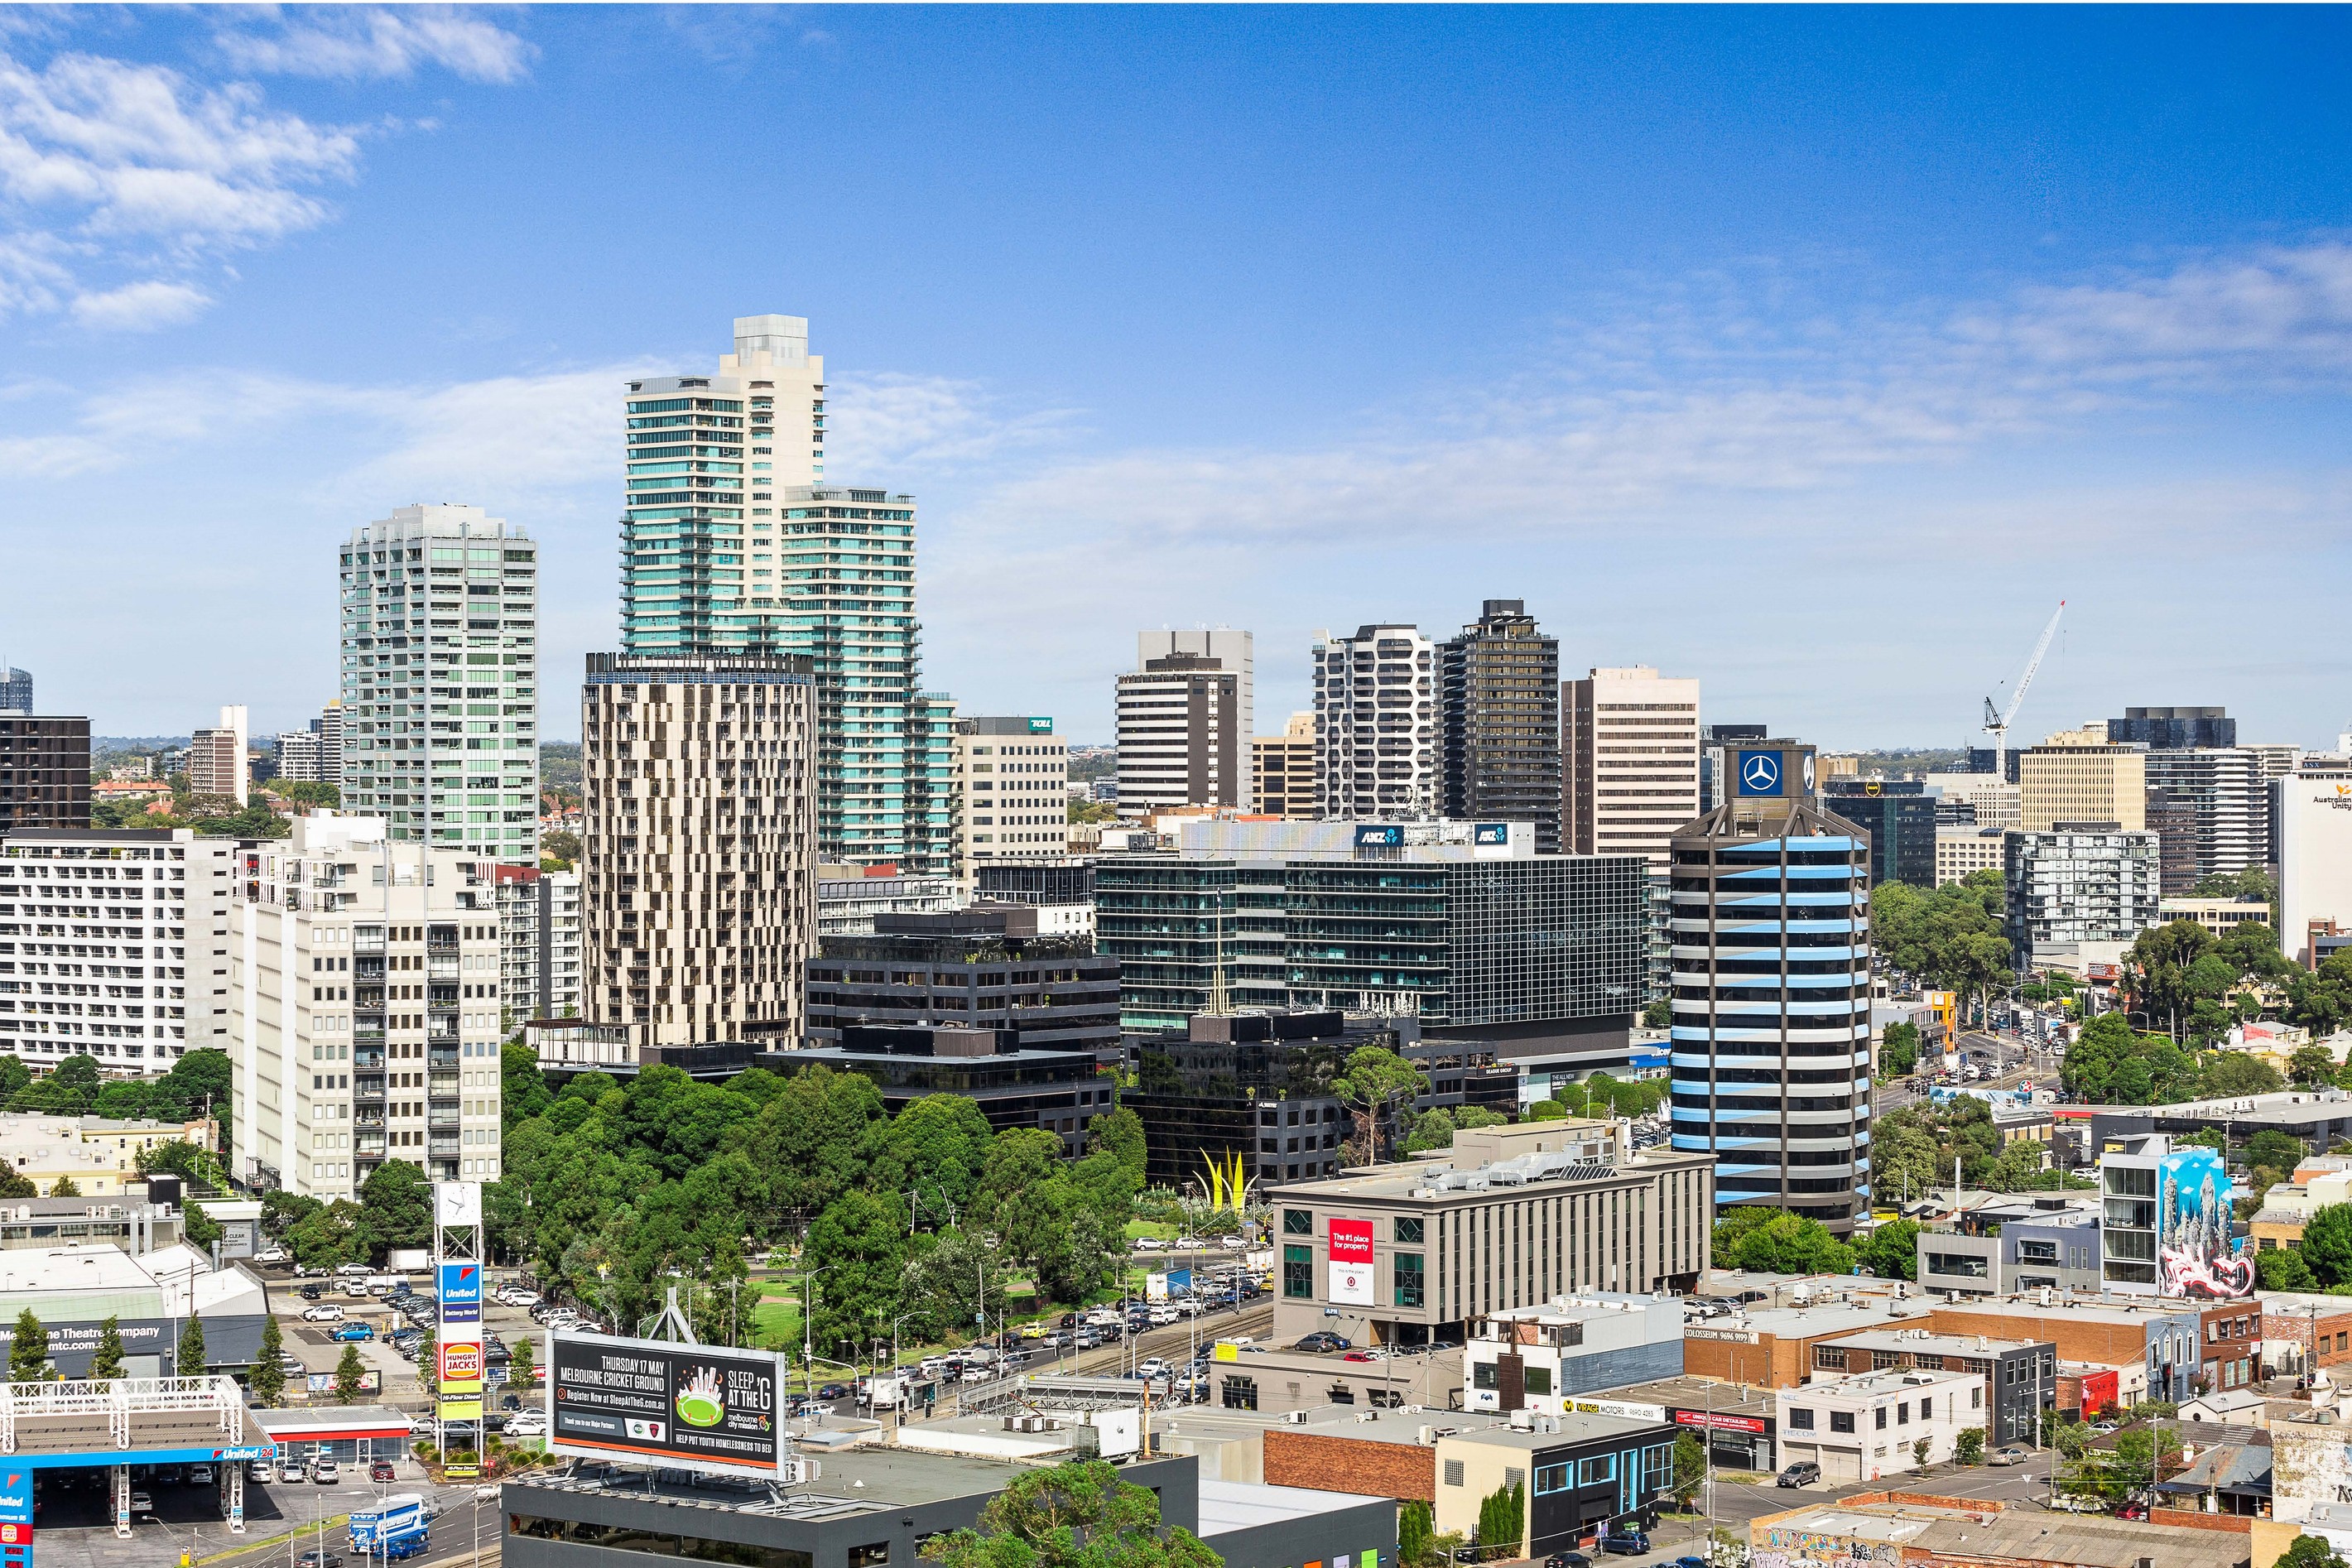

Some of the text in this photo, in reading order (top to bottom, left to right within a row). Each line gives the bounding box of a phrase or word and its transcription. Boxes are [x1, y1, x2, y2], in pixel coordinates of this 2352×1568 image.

[1031, 719, 1051, 728] TOLL
[2331, 802, 2352, 811] Unity
[1361, 832, 1386, 844] ANZ
[1479, 831, 1497, 842] ANZ
[1333, 1232, 1369, 1243] The #1 place
[1343, 1243, 1368, 1252] property
[445, 1288, 477, 1298] United
[62, 1327, 104, 1340] Theatre
[1685, 1329, 1748, 1341] COLOSSEUM 9696 9199
[48, 1341, 105, 1351] mtc.com.a
[601, 1355, 665, 1376] THURSDAY 17 MAY
[560, 1367, 665, 1392] MELBOURNE CRICKET GROUND
[728, 1370, 754, 1390] SLEEP
[566, 1389, 666, 1410] Register Now at SleepAtTheG.com.au
[728, 1389, 758, 1407] AT THE
[1576, 1402, 1599, 1413] VIRAGE
[1599, 1407, 1625, 1415] MOTORS
[564, 1416, 575, 1425] Thank
[590, 1420, 601, 1428] Major
[600, 1421, 615, 1430] Partners
[728, 1414, 758, 1423] melbourne
[728, 1421, 738, 1430] city
[676, 1434, 772, 1454] HELP PUT YOUTH HOMELESSNESS TO BED
[223, 1447, 274, 1460] United 24
